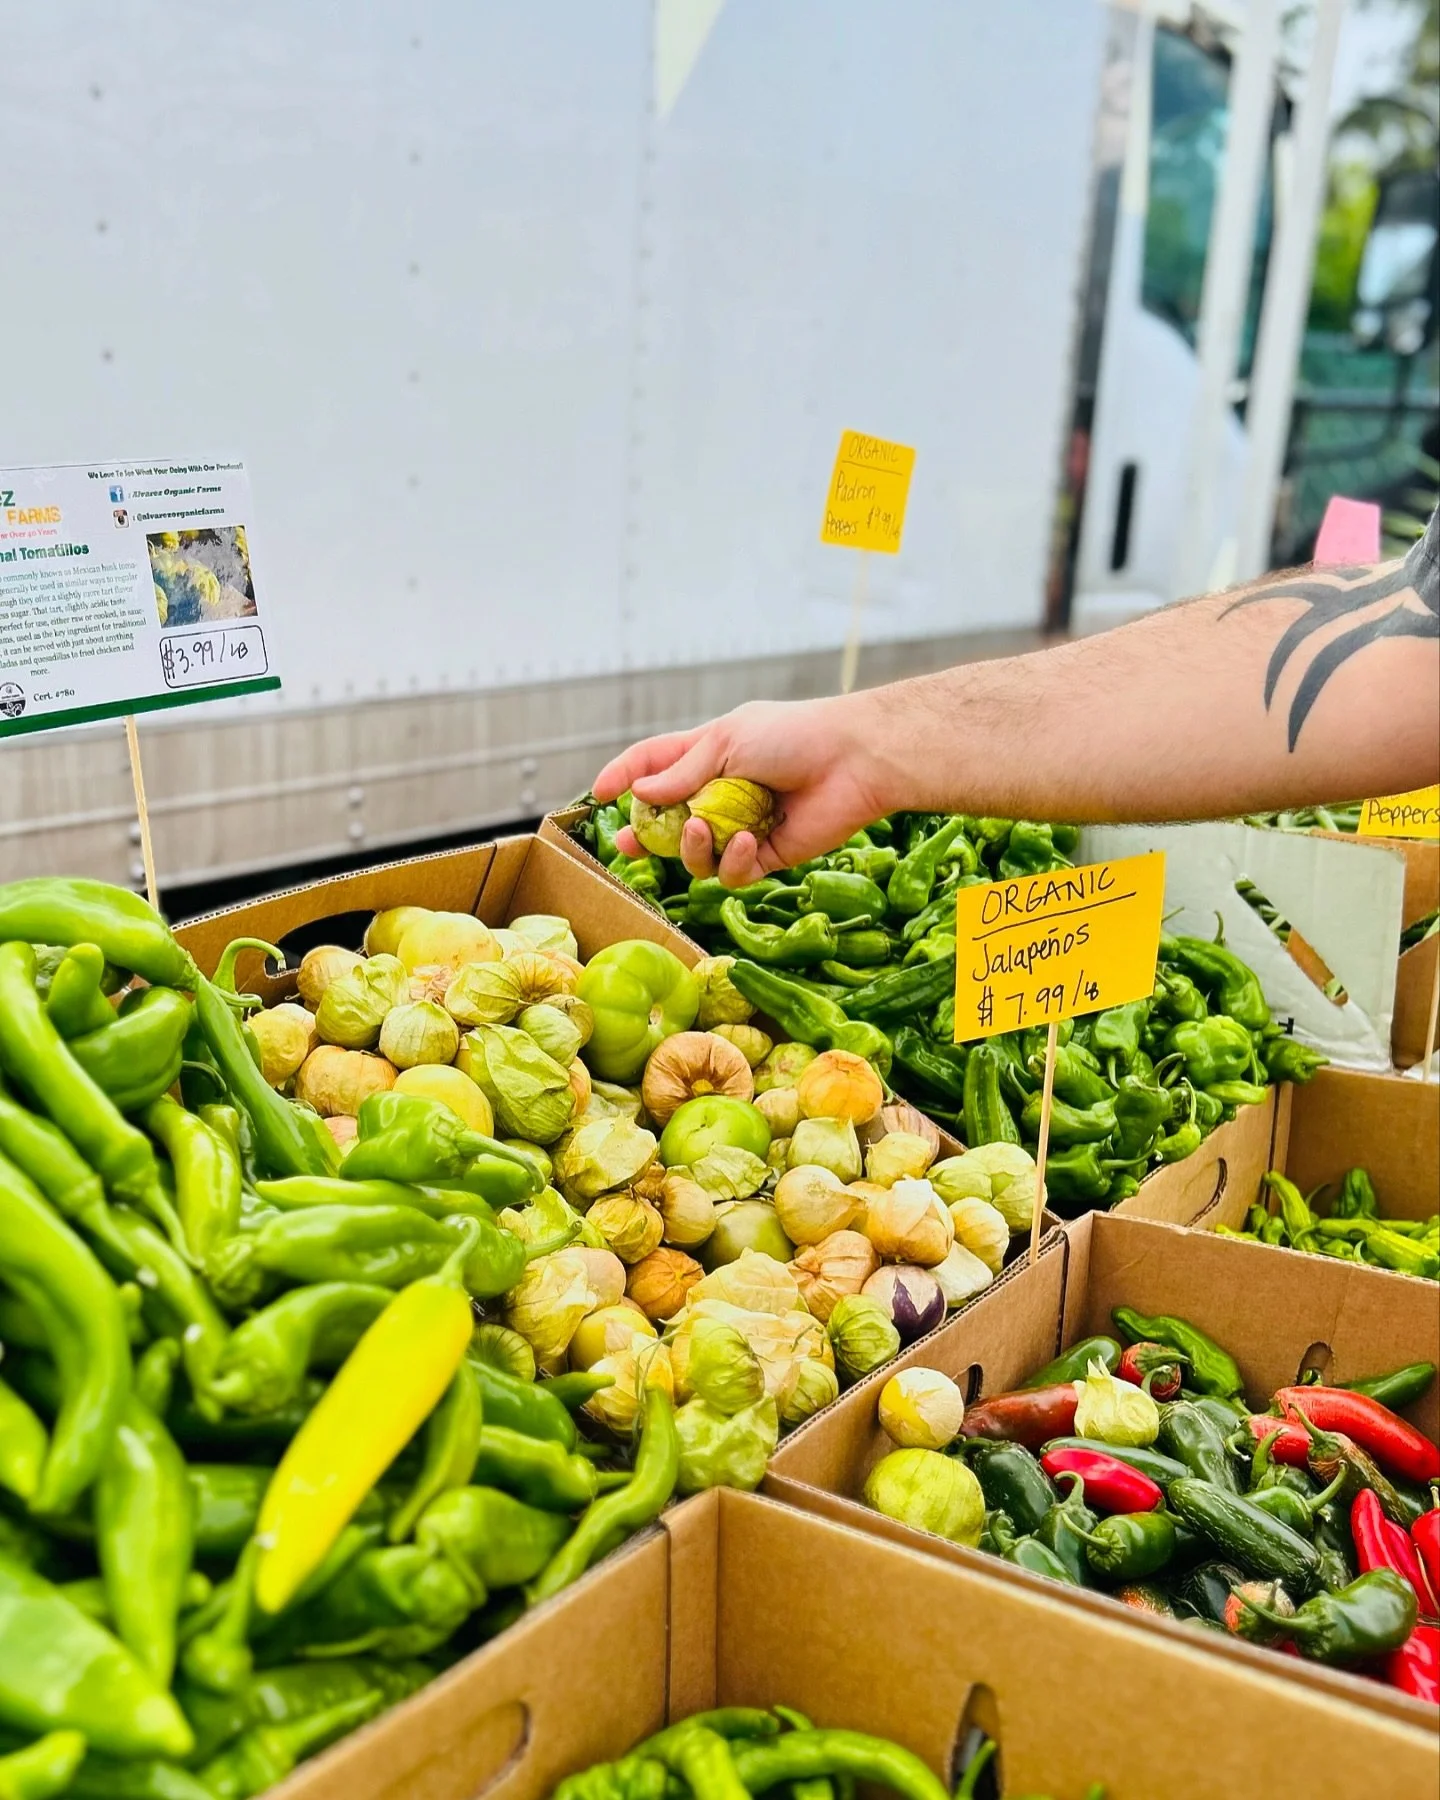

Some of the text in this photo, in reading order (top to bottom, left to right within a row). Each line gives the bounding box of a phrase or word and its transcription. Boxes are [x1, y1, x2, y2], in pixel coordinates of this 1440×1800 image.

[848, 435, 899, 463] ORGANIC
[135, 468, 153, 476] What
[154, 467, 169, 475] Your
[169, 466, 188, 474] Doing
[132, 490, 163, 498] Alvarez
[164, 487, 196, 497] Organic
[835, 470, 877, 503] Padron
[7, 506, 61, 525] FARMS
[19, 543, 90, 560] Tomatillos
[39, 570, 63, 578] known
[18, 596, 33, 606] they
[32, 606, 48, 616] That
[24, 620, 34, 629] for
[42, 630, 53, 639] the
[54, 628, 66, 638] key
[102, 622, 112, 631] for
[113, 616, 147, 630] traditional
[22, 644, 32, 653] be
[56, 639, 71, 649] with
[85, 635, 105, 645] about
[20, 656, 32, 666] and
[79, 647, 95, 658] fried
[96, 645, 121, 655] chicken
[122, 642, 135, 652] and
[33, 692, 53, 701] Cert.
[981, 867, 1115, 925] ORGANIC
[972, 923, 1090, 982] Jalapeños
